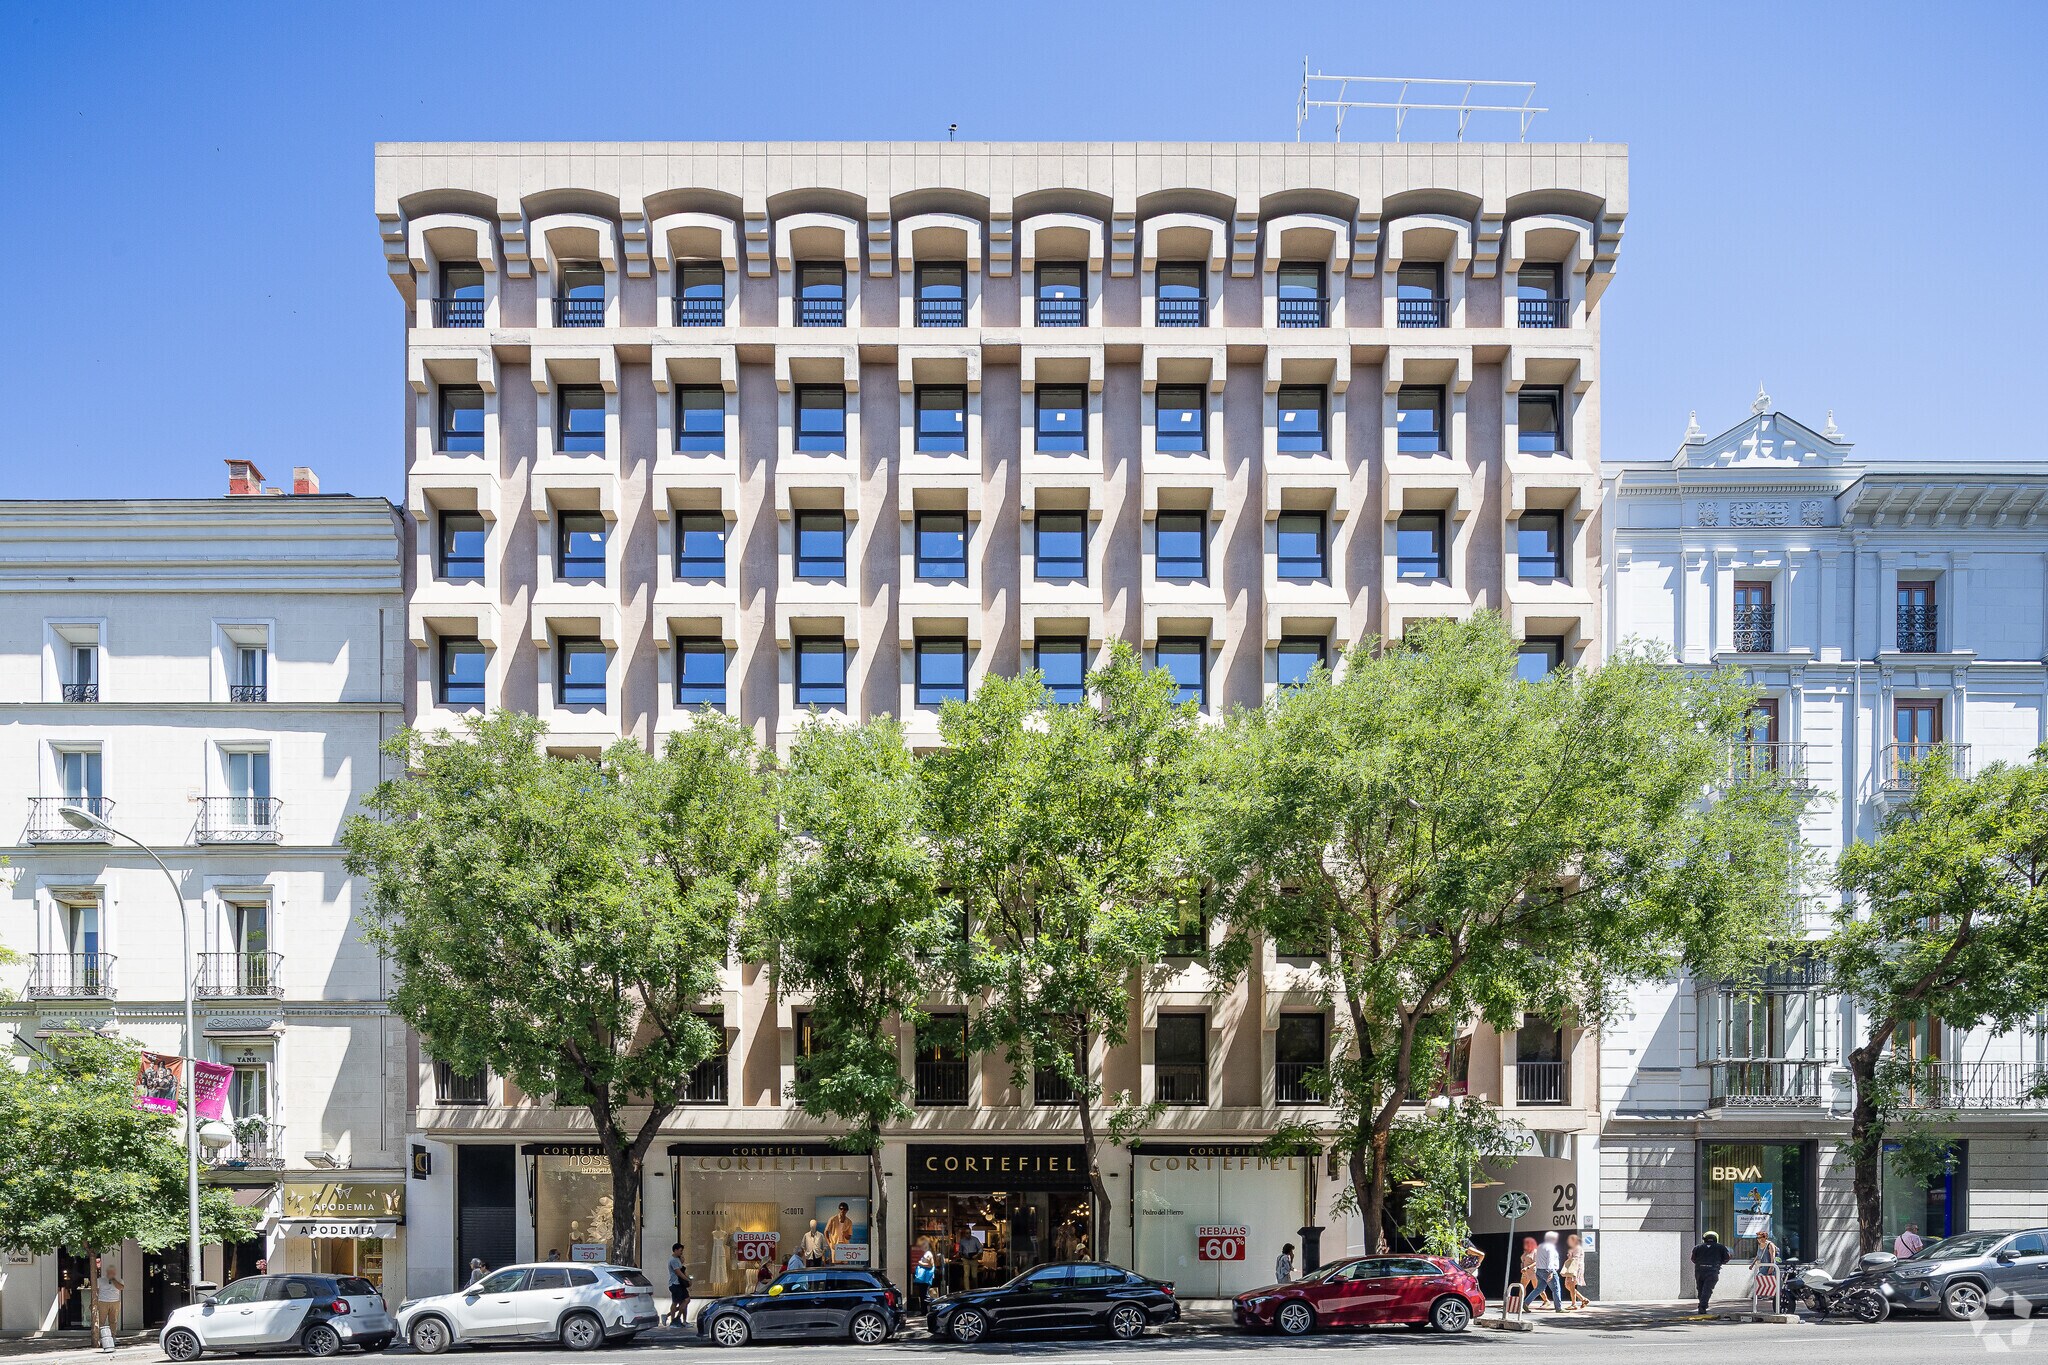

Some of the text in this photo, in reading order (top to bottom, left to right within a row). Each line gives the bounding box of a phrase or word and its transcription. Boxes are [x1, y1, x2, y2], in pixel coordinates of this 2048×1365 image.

[732, 1147, 805, 1156] CORTEFIEL
[699, 1156, 849, 1171] CORTEFIEL
[926, 1156, 1077, 1172] CORTEFIEL
[1149, 1156, 1298, 1172] CORTEFIEL
[1712, 1165, 1762, 1181] BBVA
[1552, 1183, 1577, 1212] 29
[313, 1203, 375, 1211] APODEMIA
[1552, 1214, 1577, 1227] GOYA
[300, 1226, 375, 1235] APODEMIA
[738, 1233, 777, 1241] REBAJAS
[1199, 1227, 1246, 1235] REBAJAS
[1199, 1237, 1245, 1260] -60%
